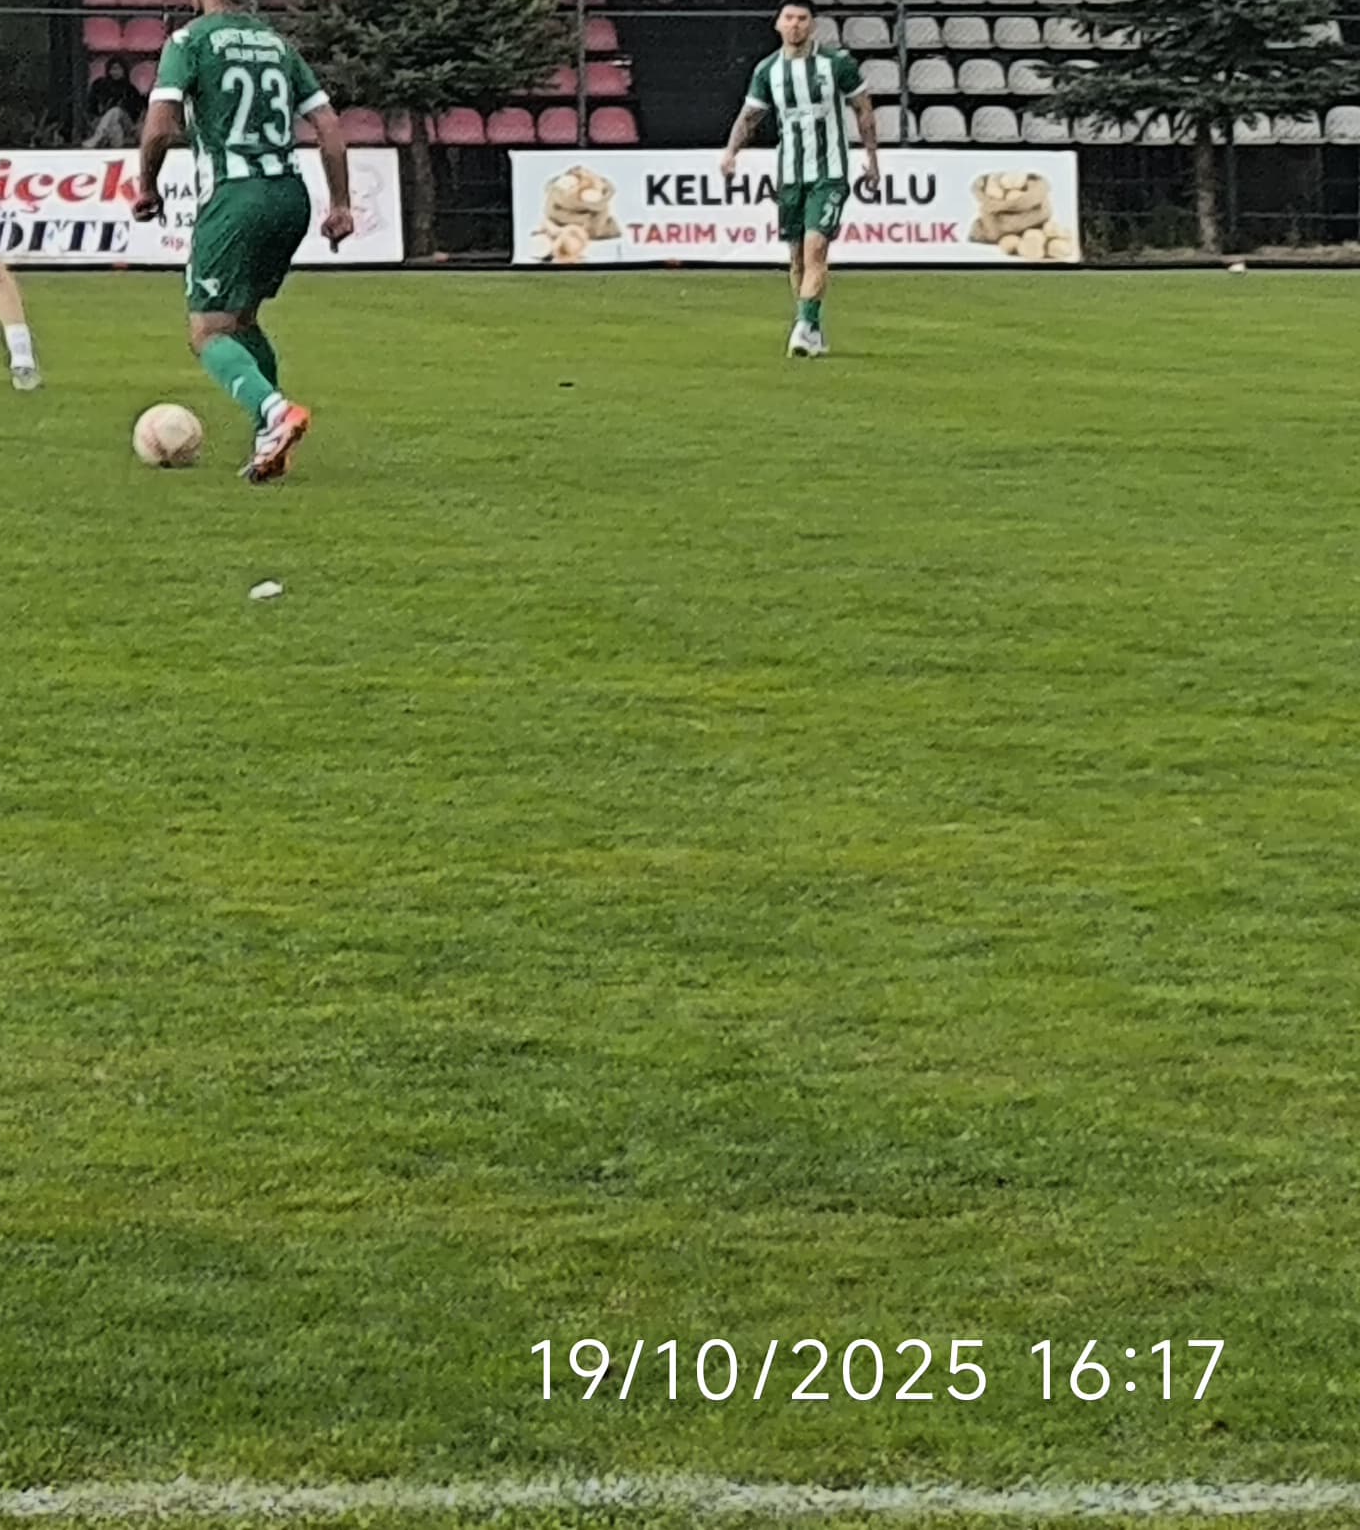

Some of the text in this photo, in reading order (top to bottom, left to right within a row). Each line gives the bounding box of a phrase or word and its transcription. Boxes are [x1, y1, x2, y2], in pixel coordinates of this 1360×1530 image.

[222, 66, 291, 147] 23
[627, 223, 716, 244] TARIM
[726, 226, 755, 243] ve
